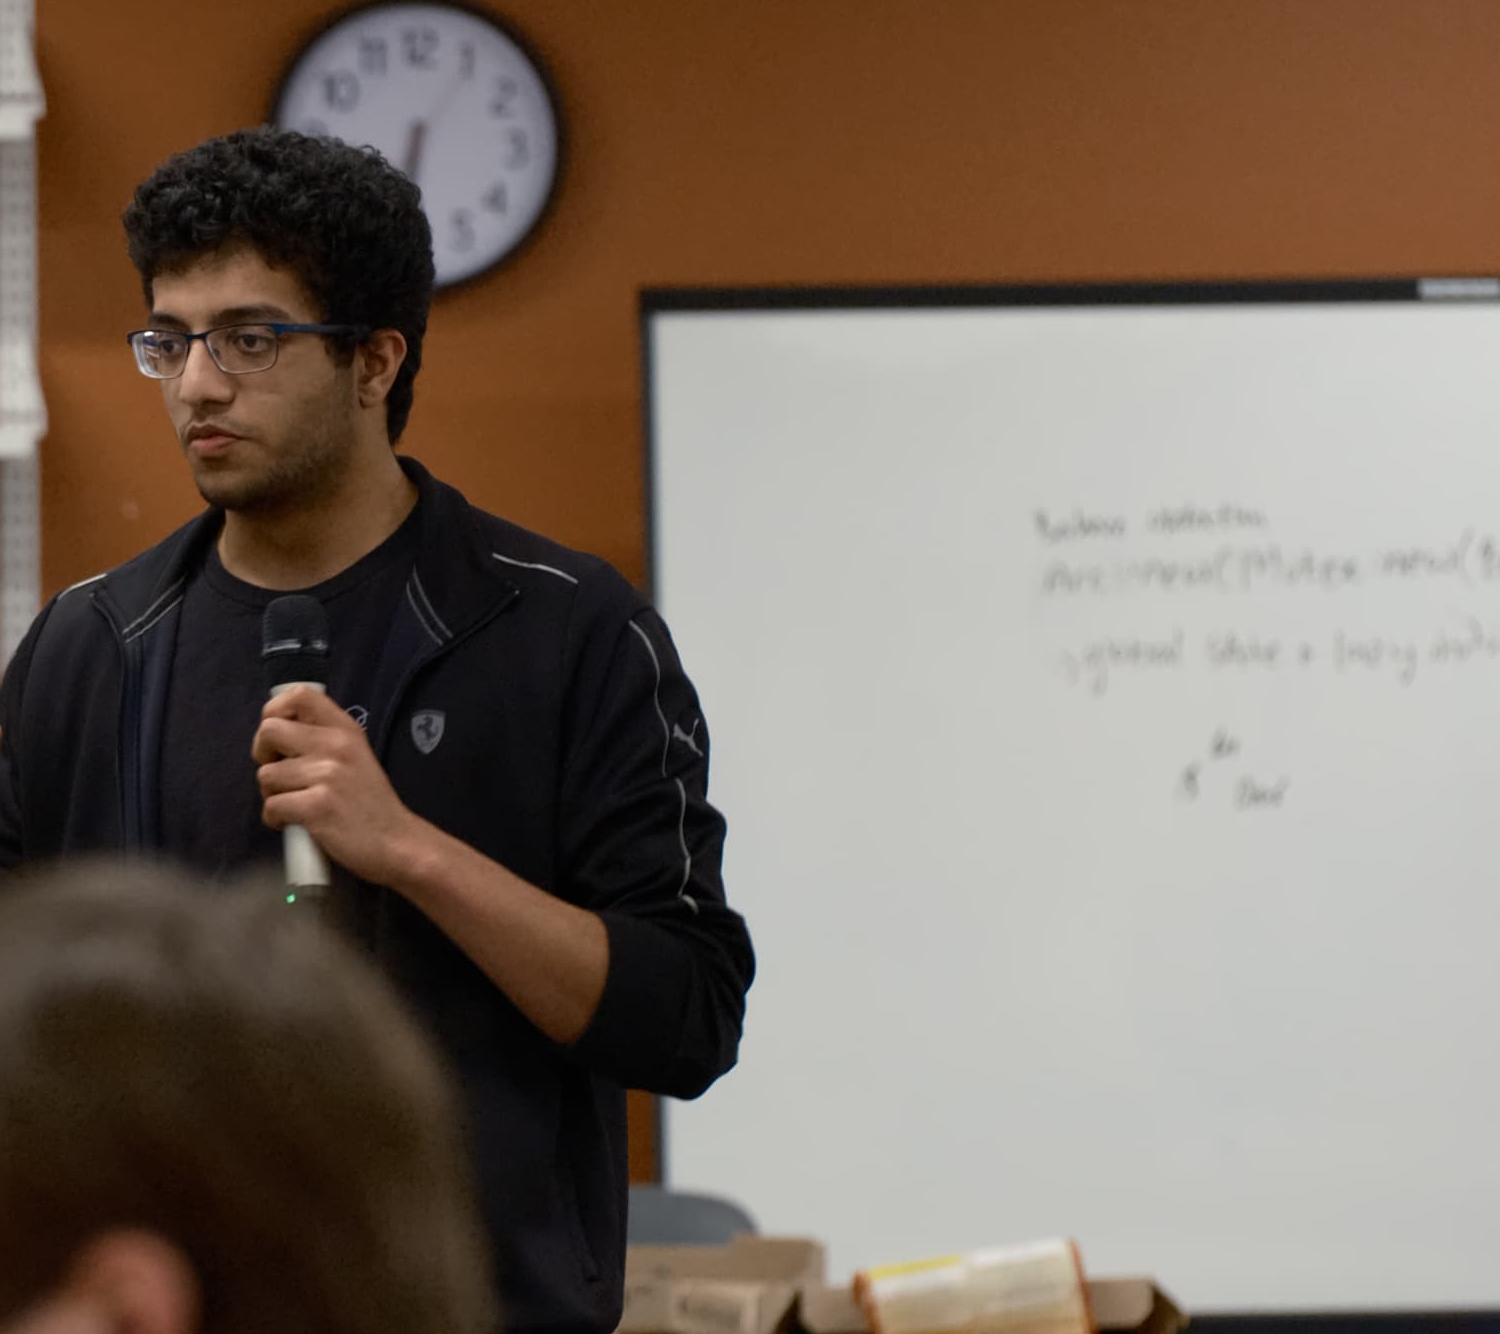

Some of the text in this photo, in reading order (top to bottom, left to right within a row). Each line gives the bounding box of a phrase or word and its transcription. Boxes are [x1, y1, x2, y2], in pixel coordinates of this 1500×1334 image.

[402, 26, 439, 69] 12
[322, 68, 361, 113] 10
[490, 73, 518, 119] 2
